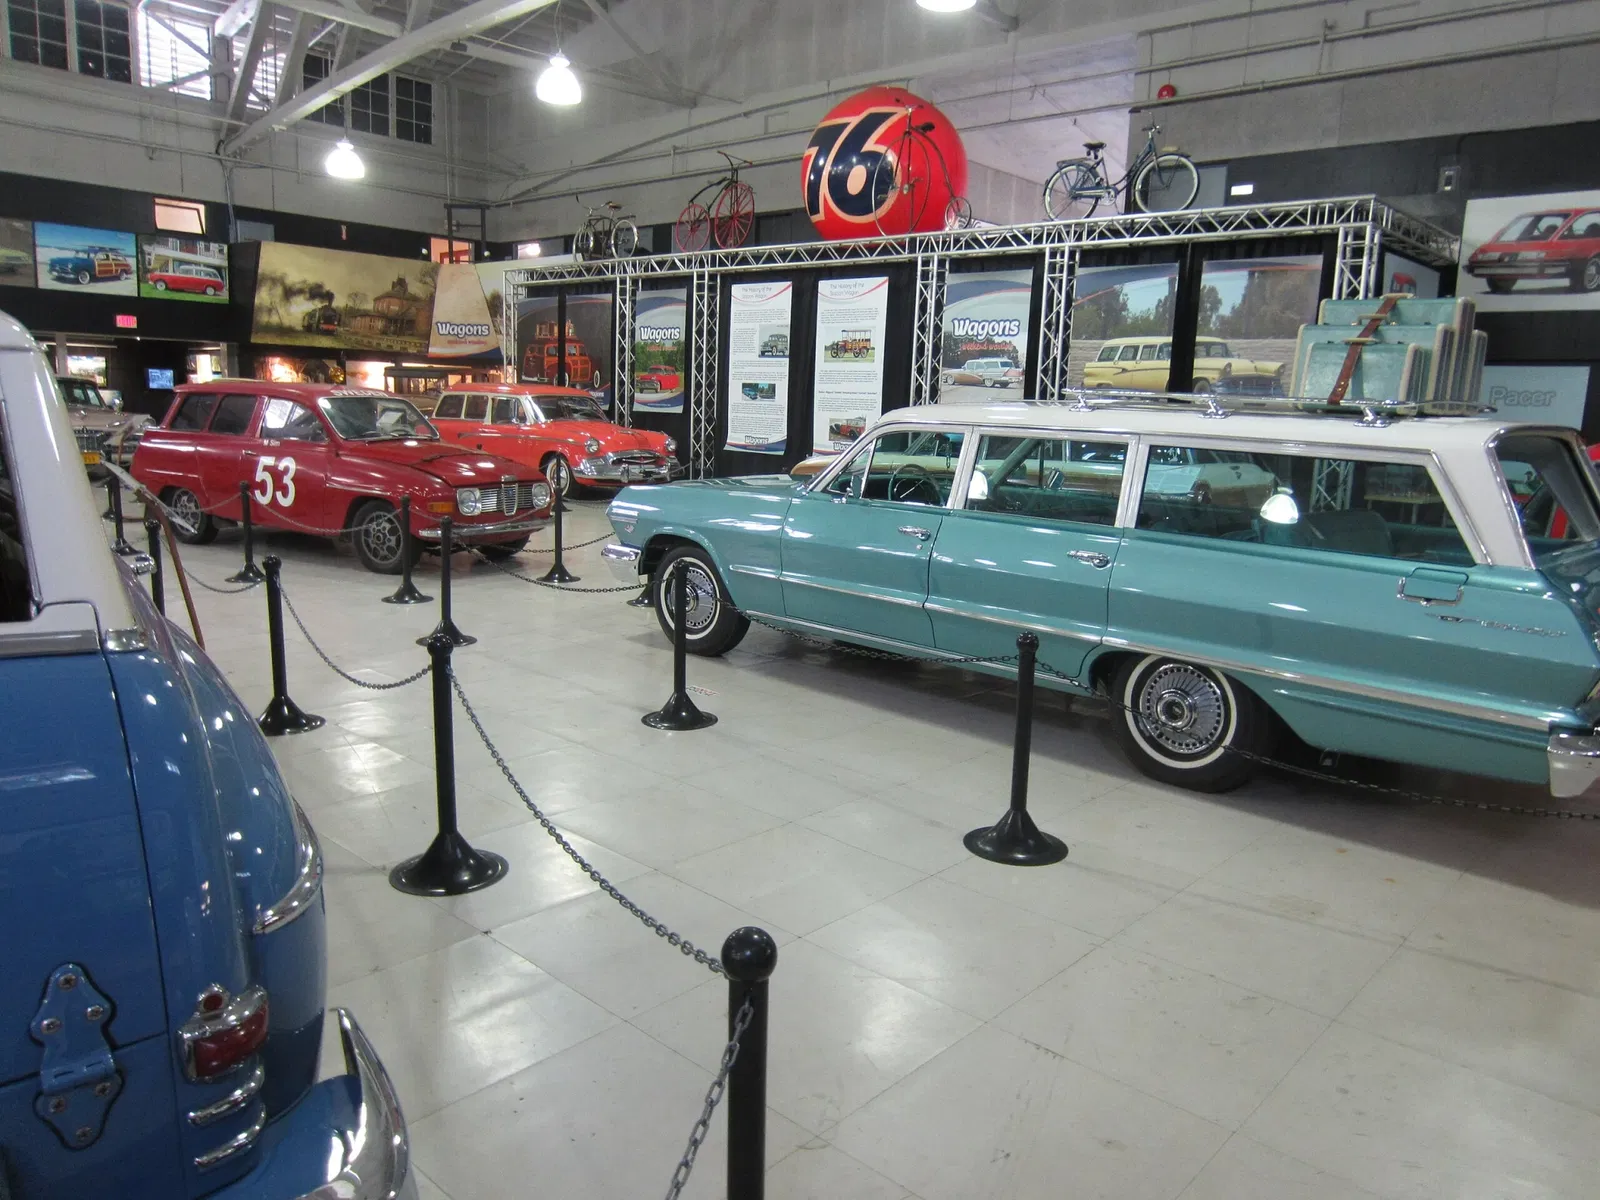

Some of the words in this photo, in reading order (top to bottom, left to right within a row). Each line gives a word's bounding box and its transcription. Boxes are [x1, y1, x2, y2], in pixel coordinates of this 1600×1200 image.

[802, 106, 903, 224] 76
[436, 321, 490, 339] Wagons
[639, 326, 681, 343] Wagons
[952, 317, 1021, 341] Wagons
[1489, 386, 1557, 407] Pacer
[254, 455, 296, 507] 53
